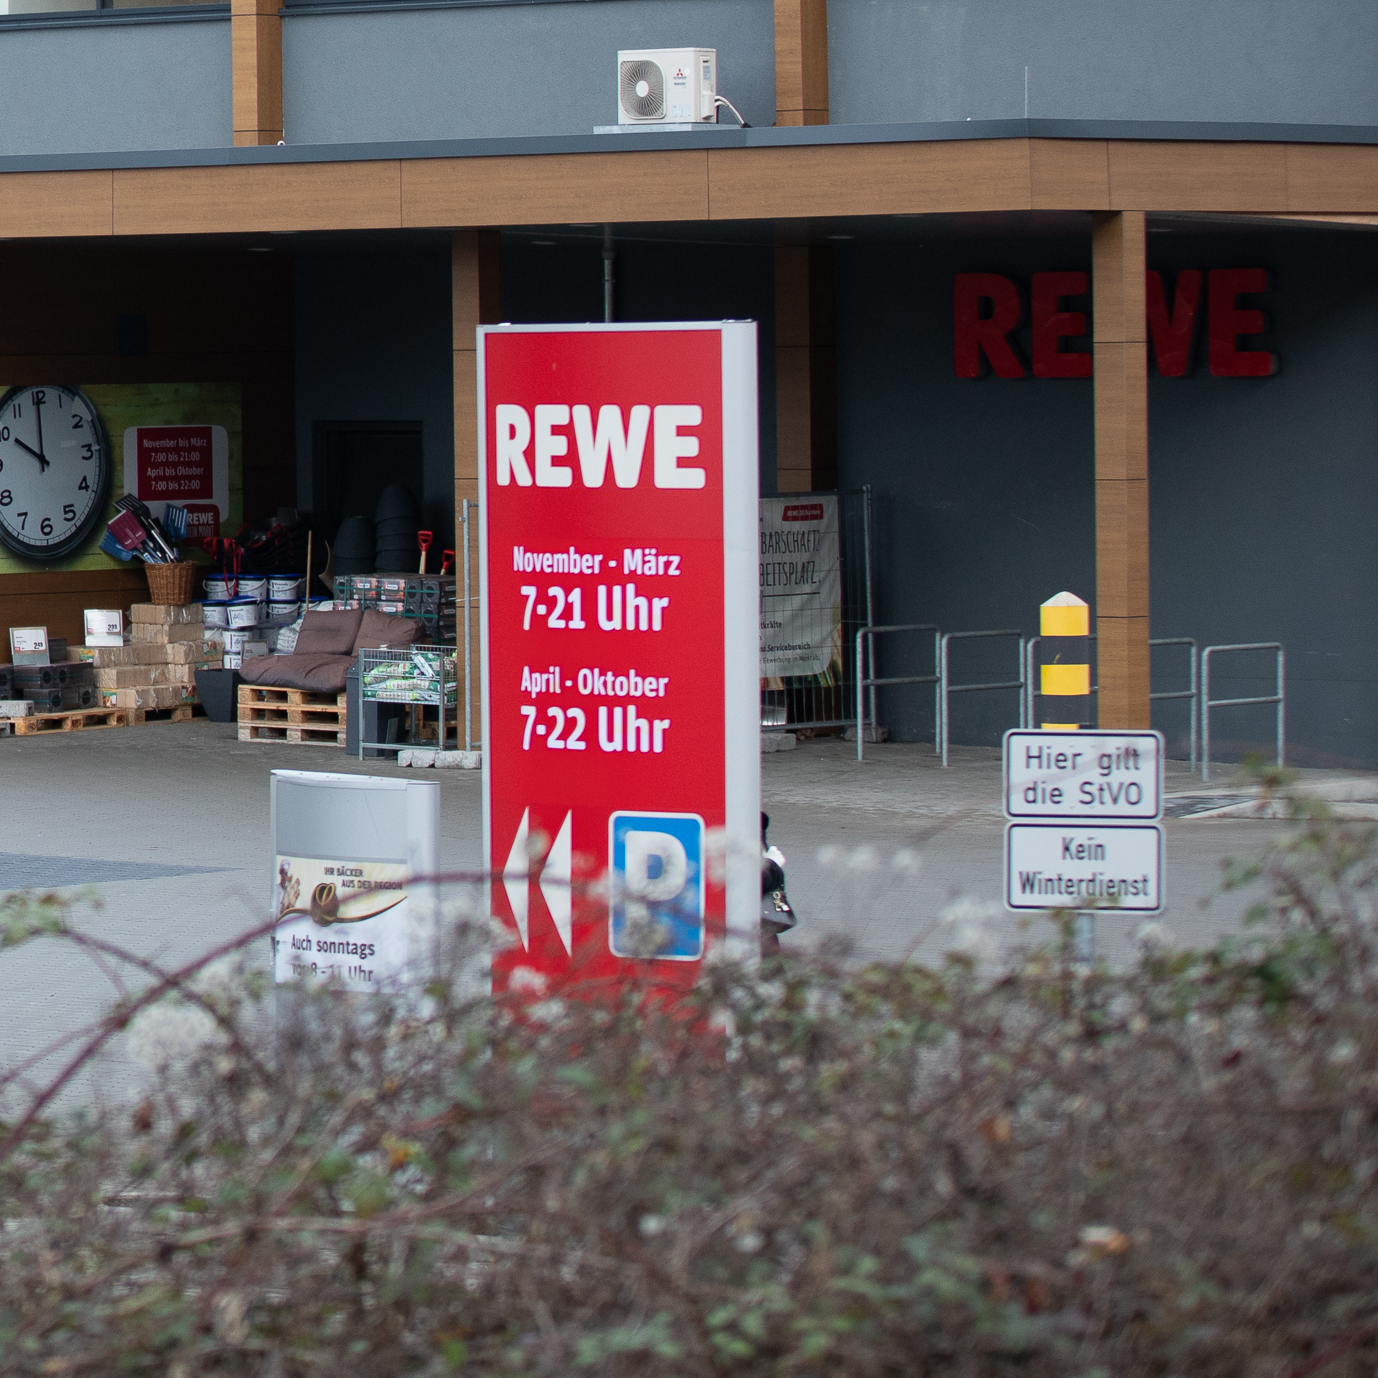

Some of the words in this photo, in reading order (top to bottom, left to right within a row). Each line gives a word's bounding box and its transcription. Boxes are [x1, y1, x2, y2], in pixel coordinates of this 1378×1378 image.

[13, 403, 22, 419] 11
[71, 414, 84, 429] 2
[143, 438, 177, 448] November
[178, 438, 189, 447] bis
[190, 437, 207, 447] März
[496, 404, 706, 489] REWE
[81, 443, 94, 461] 3
[151, 453, 166, 462] 7:00
[167, 452, 178, 462] bis
[180, 452, 200, 461] 21:00
[147, 467, 164, 478] April
[165, 466, 176, 476] bis
[177, 465, 204, 476] Oktober
[77, 475, 90, 492] 4
[151, 481, 167, 491] 7:00
[168, 481, 179, 490] bis
[180, 480, 200, 490] 22:00
[0, 489, 13, 506] 8
[16, 512, 28, 531] 7
[62, 503, 77, 522] 5
[187, 512, 214, 525] REWE
[40, 517, 54, 536] 6
[513, 546, 603, 574] November
[623, 548, 681, 576] März
[597, 583, 669, 632] Uhr
[768, 642, 811, 652] Servicebereich
[521, 666, 561, 698] April
[577, 668, 669, 698] Oktober
[598, 705, 670, 754] Uhr
[1025, 745, 1083, 770] Hier
[1098, 747, 1141, 777] gilt
[1024, 781, 1063, 804] die
[1079, 781, 1142, 805] StVO
[1061, 837, 1106, 861] Kein
[324, 867, 335, 876] IHR
[337, 865, 363, 877] BÄCKER
[341, 880, 355, 889] AUS
[357, 880, 371, 889] DER
[373, 881, 403, 890] REGION
[1018, 871, 1150, 898] Winterdienst
[291, 934, 312, 952] Auch
[316, 938, 375, 959] sonntags
[348, 965, 374, 982] Uhr
